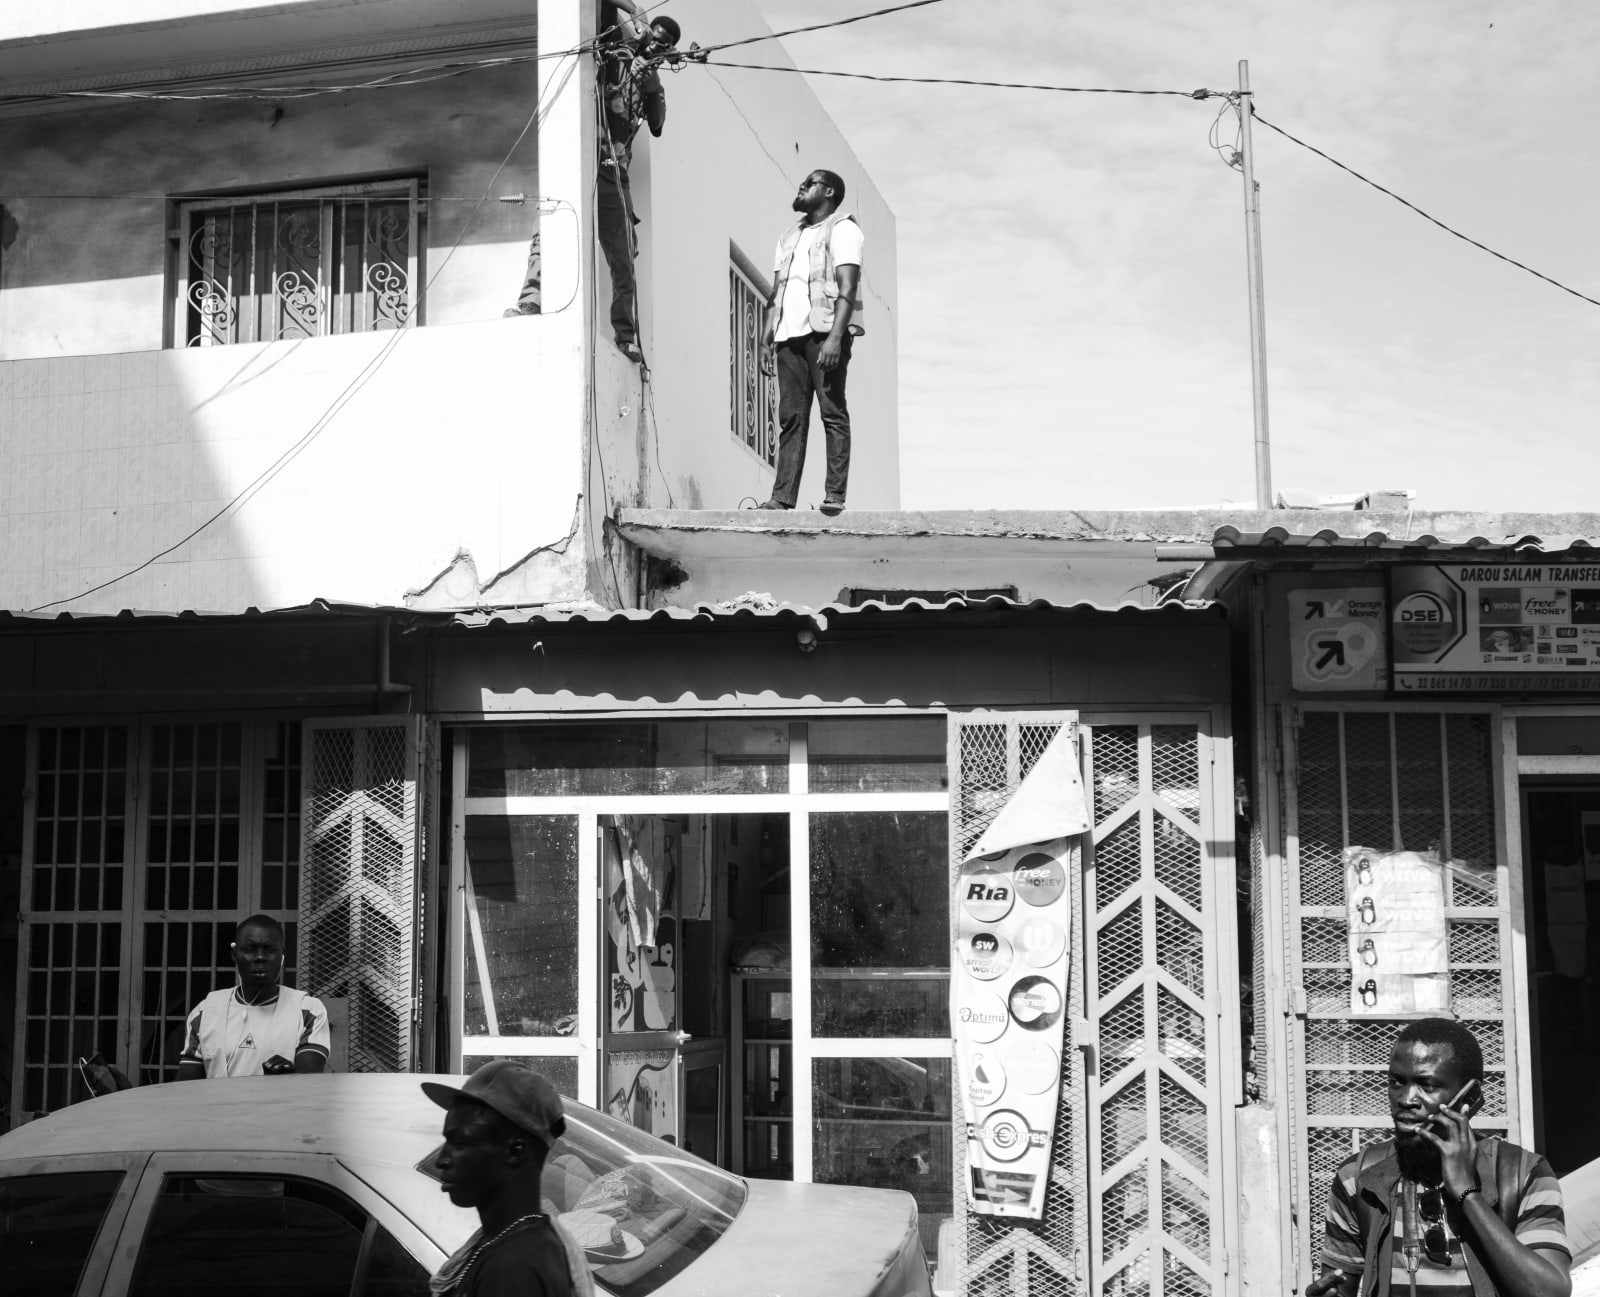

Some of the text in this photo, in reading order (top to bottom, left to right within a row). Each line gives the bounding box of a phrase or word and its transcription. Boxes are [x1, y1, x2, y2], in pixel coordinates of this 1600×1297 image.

[1460, 567, 1600, 582] DAROU SALAM TRANSFE
[1348, 600, 1382, 610] Orange
[1492, 601, 1521, 610] wave
[1525, 597, 1557, 611] free
[1348, 610, 1379, 620] Money
[1400, 609, 1438, 622] DSE
[1533, 607, 1567, 616] MONEY
[1014, 866, 1051, 881] free
[1025, 878, 1062, 888] MONEY
[966, 883, 1009, 901] Ria
[959, 1007, 1005, 1024] Optima
